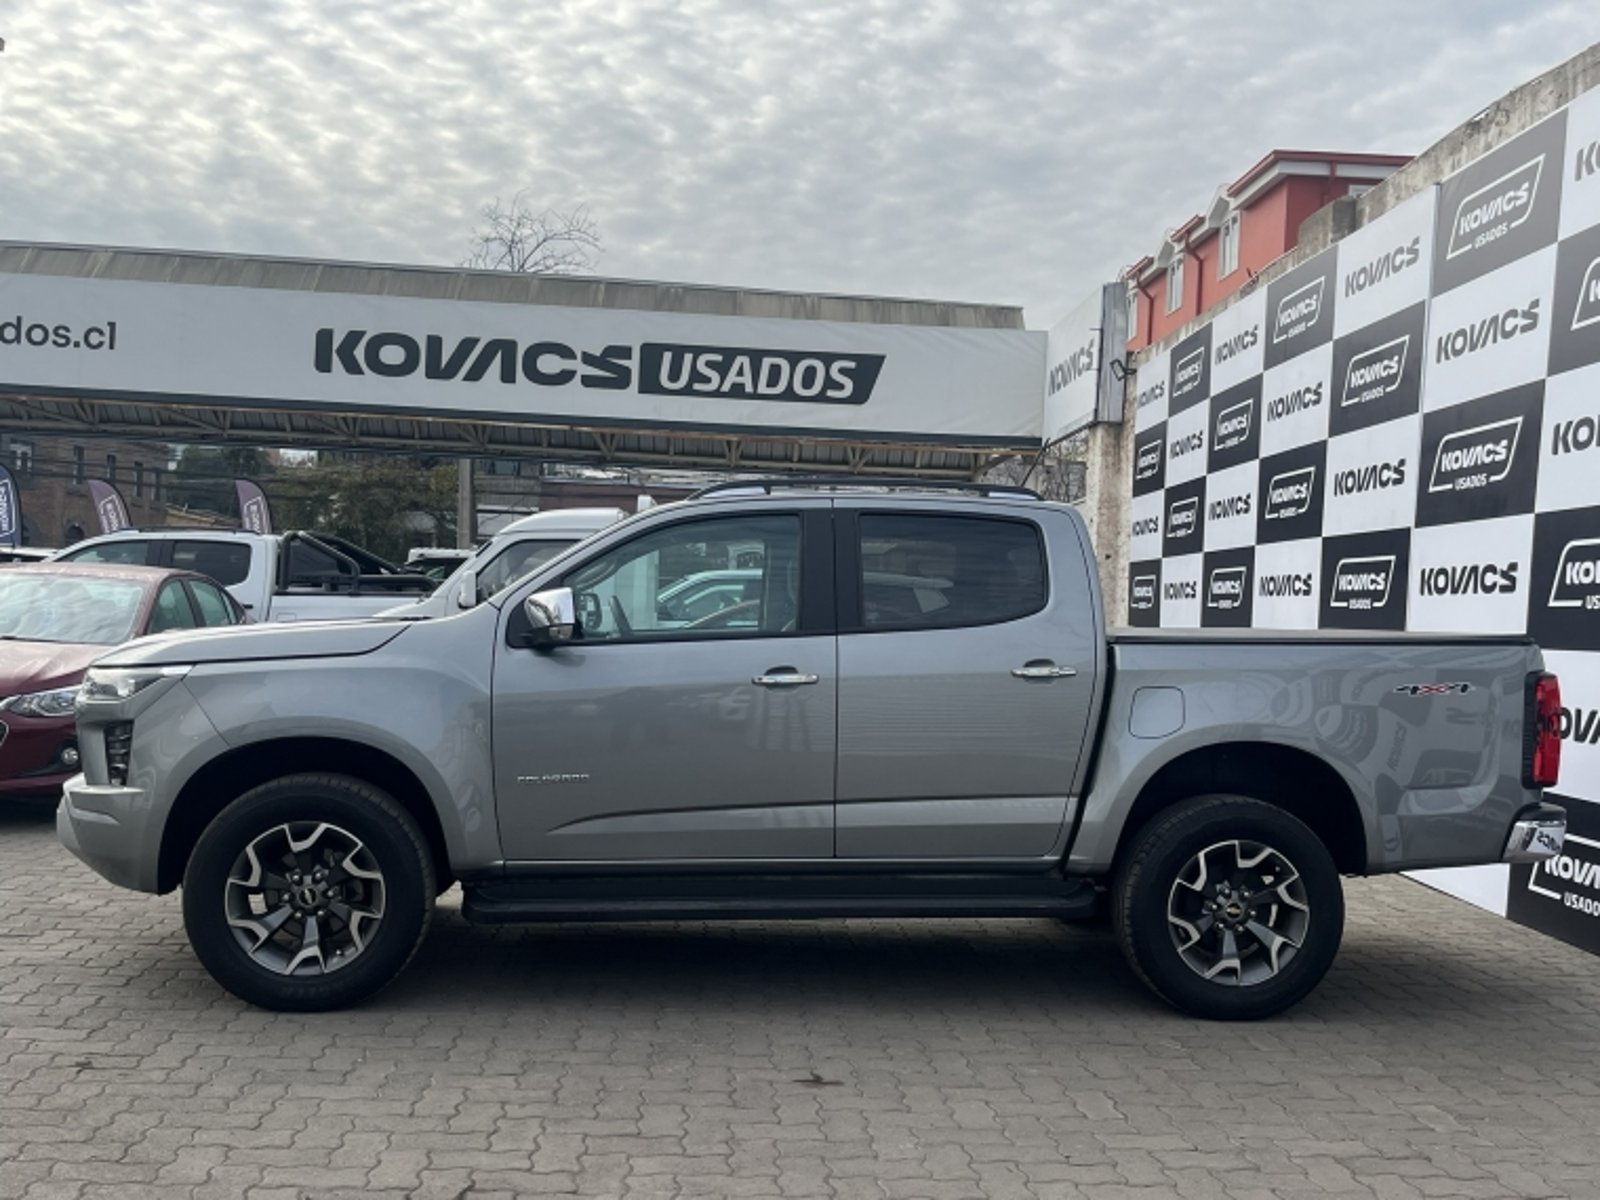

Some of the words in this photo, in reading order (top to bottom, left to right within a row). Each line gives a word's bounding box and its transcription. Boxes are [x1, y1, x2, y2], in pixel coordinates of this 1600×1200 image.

[1575, 140, 1600, 181] K
[1459, 182, 1529, 236] KOVACS
[1344, 236, 1420, 298] KOVACS
[0, 315, 117, 350] dos.cl
[1436, 299, 1540, 364] KOVACS
[314, 328, 633, 391] KOVACS
[657, 351, 857, 399] USADOS
[1350, 355, 1399, 389] KOVACS
[1266, 380, 1323, 422] KOVACS
[1551, 414, 1600, 455] KO
[1441, 439, 1509, 472] KOVACS
[1334, 458, 1407, 497] KOVACS
[1454, 473, 1488, 491] USADOS
[1258, 572, 1313, 597] KOVACS
[1338, 572, 1386, 591] KOVACS
[1419, 561, 1519, 596] KOVACS
[1565, 559, 1600, 585] KO
